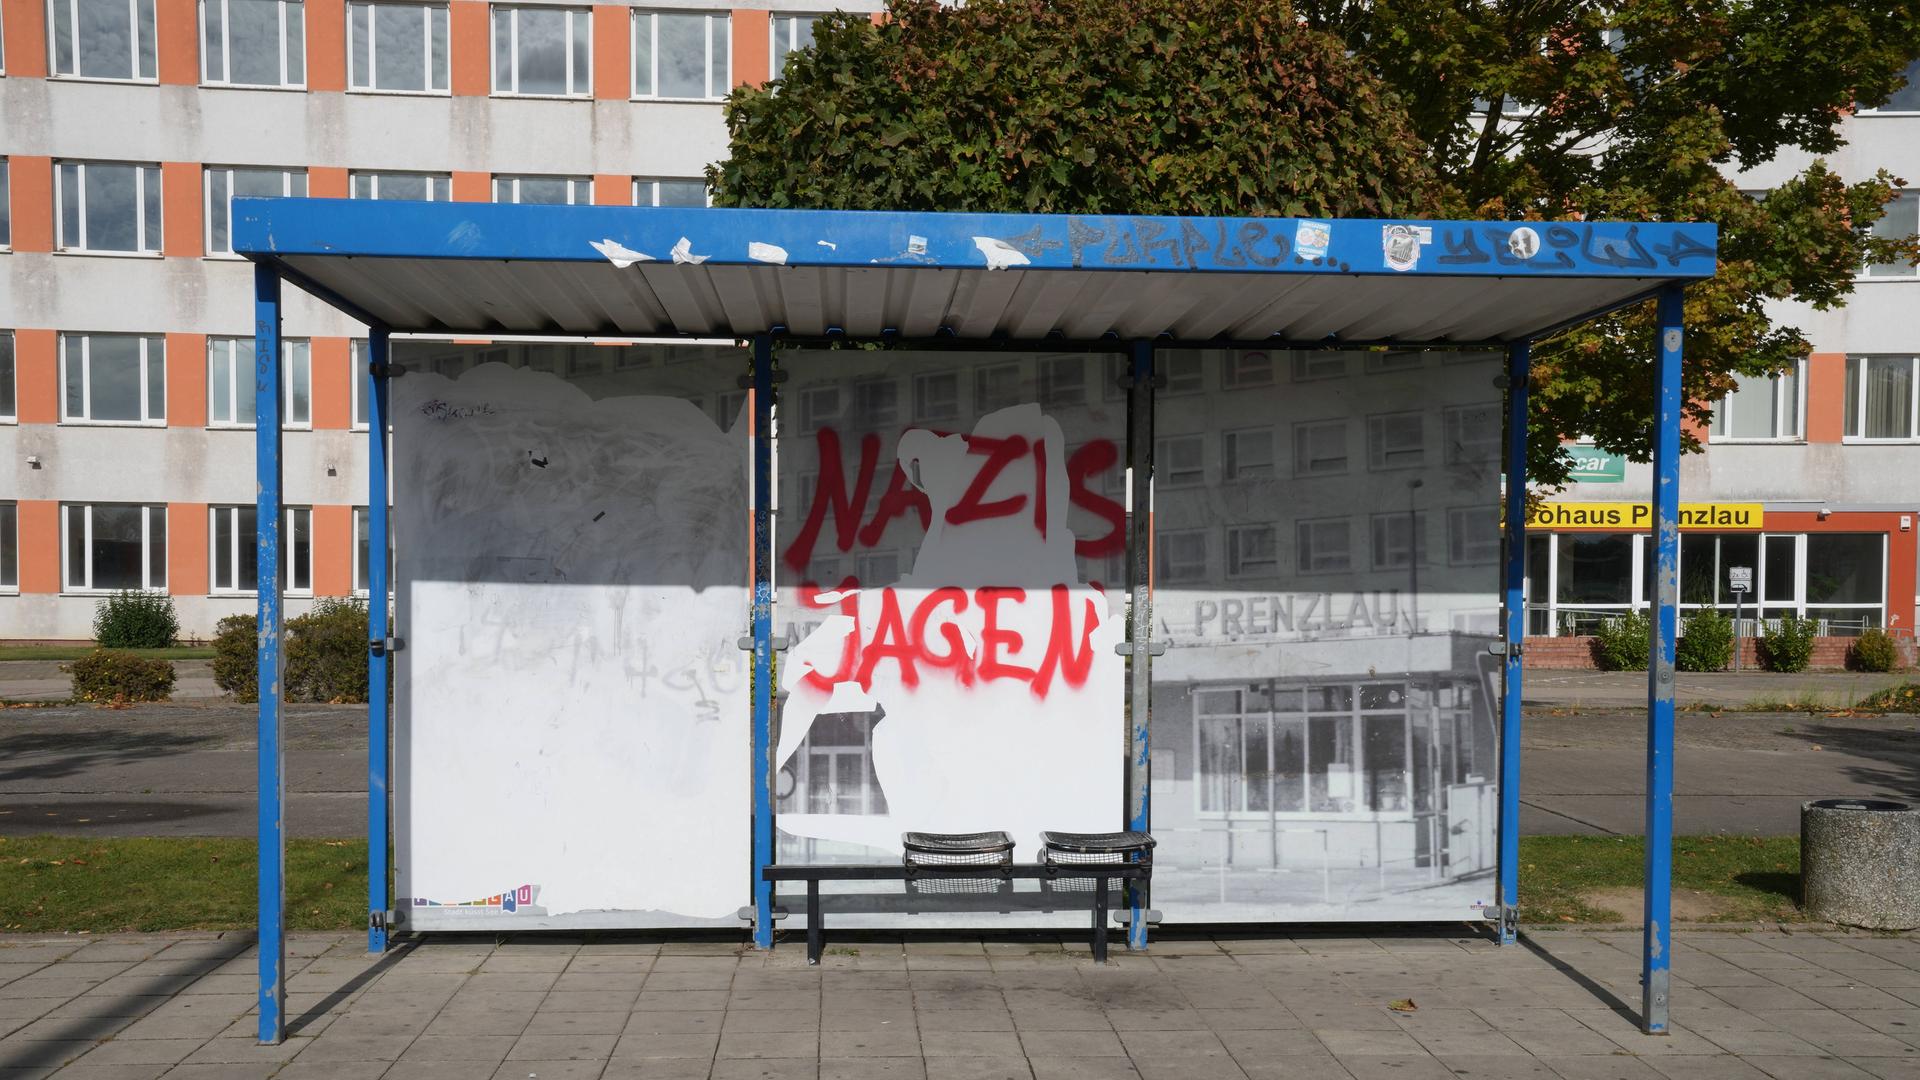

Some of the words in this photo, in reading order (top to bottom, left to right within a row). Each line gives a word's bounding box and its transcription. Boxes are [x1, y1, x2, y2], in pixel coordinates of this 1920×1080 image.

[784, 426, 1126, 571] NAZIS
[1538, 505, 1621, 524] ohaus
[1632, 505, 1749, 525] Pnzlau
[797, 576, 1106, 700] JAGEN
[1194, 590, 1399, 637] PRENZLAU
